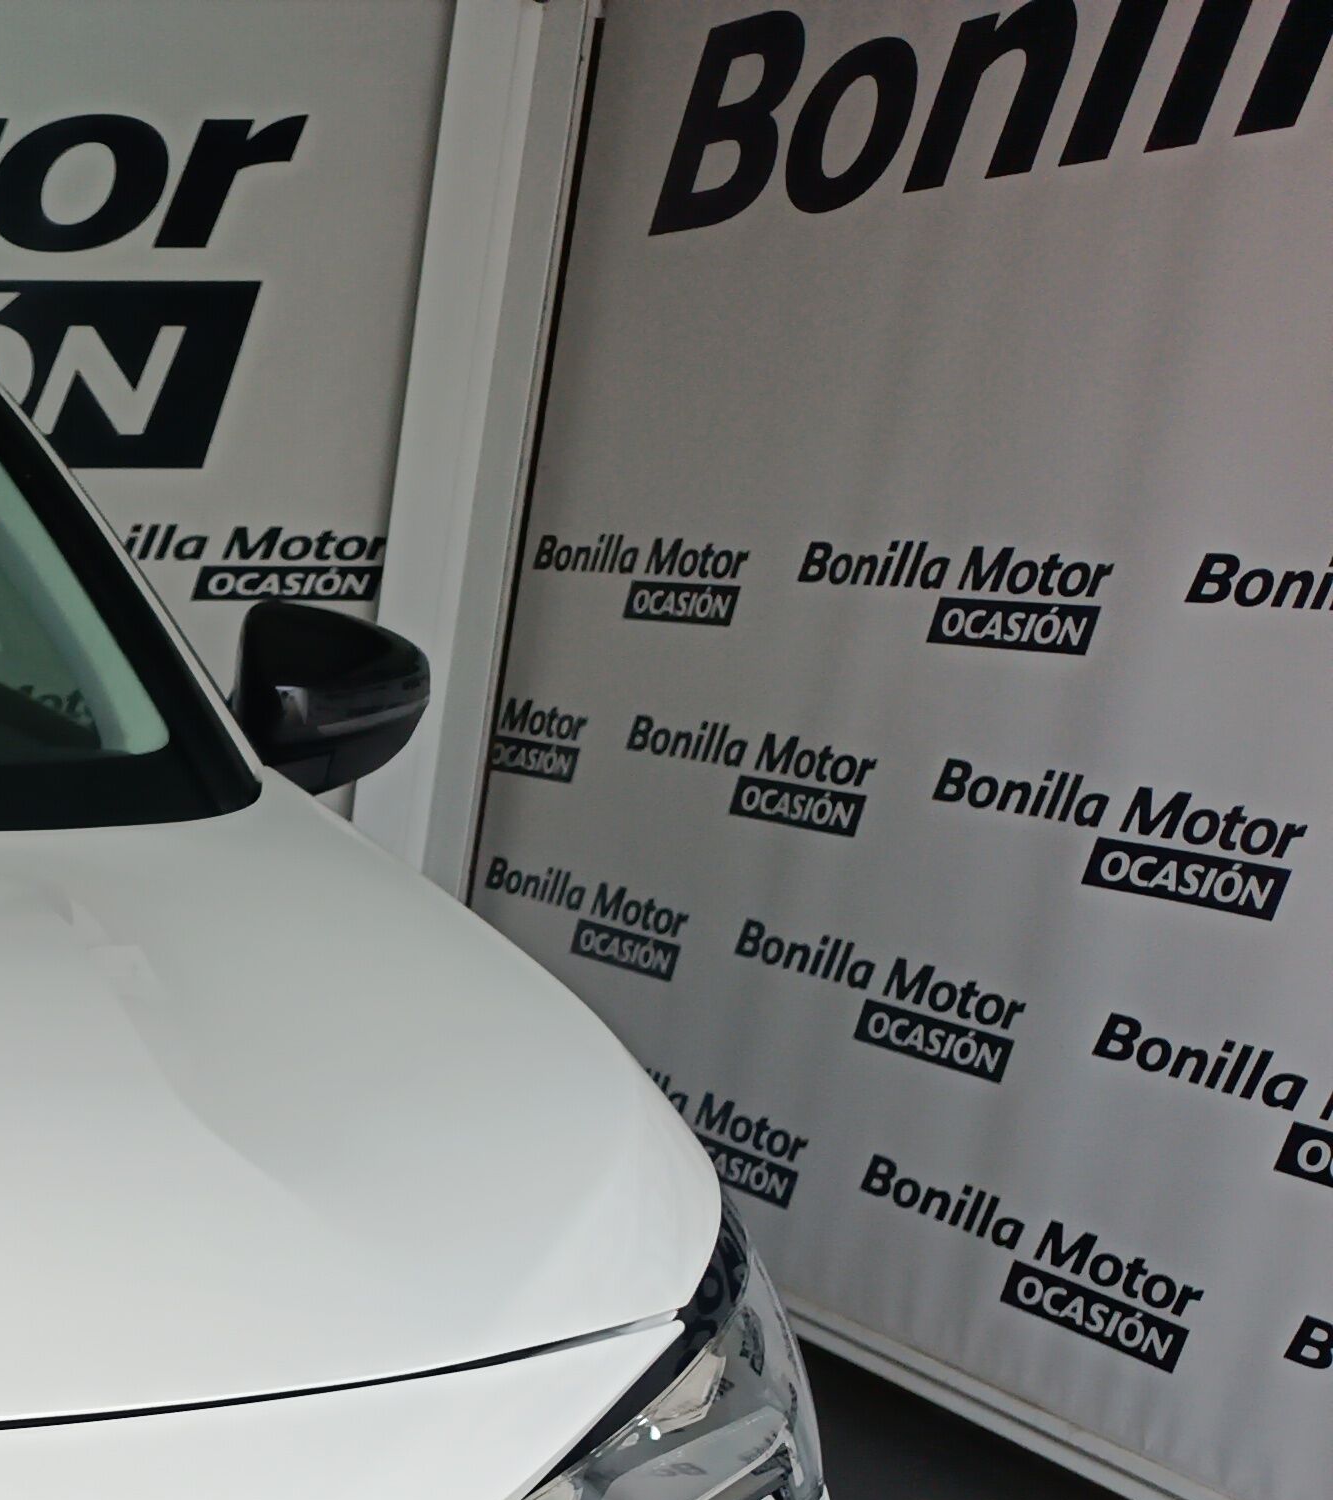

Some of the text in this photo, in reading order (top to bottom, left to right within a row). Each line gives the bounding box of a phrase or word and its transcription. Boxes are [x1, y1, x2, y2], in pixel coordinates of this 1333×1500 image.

[222, 526, 387, 561] Motor
[534, 534, 749, 580] Bonilla Motor
[797, 541, 1115, 599] Bonilla Motor
[207, 567, 371, 596] OCASIÓN
[633, 585, 733, 620] OCASIÓN
[941, 609, 1088, 648] OCASIÓN
[501, 697, 589, 741] Motor
[626, 715, 877, 787] Bonilla Motor
[741, 783, 856, 828] OCASIÓN
[933, 757, 1307, 860] Bonilla Motor
[486, 857, 690, 939] Bonilla Motor
[1099, 850, 1276, 912] OCASIÓN
[579, 927, 673, 974] OCASIÓN
[735, 918, 1027, 1030] Bonilla Motor
[866, 1010, 1003, 1074] OCASIÓN
[1092, 1012, 1309, 1112] Bonilla
[694, 1091, 810, 1163] Motor
[705, 1145, 789, 1199] ASIÓN
[859, 1153, 1204, 1318] Bonilla Motor
[1016, 1275, 1174, 1361] OCASIÓN
